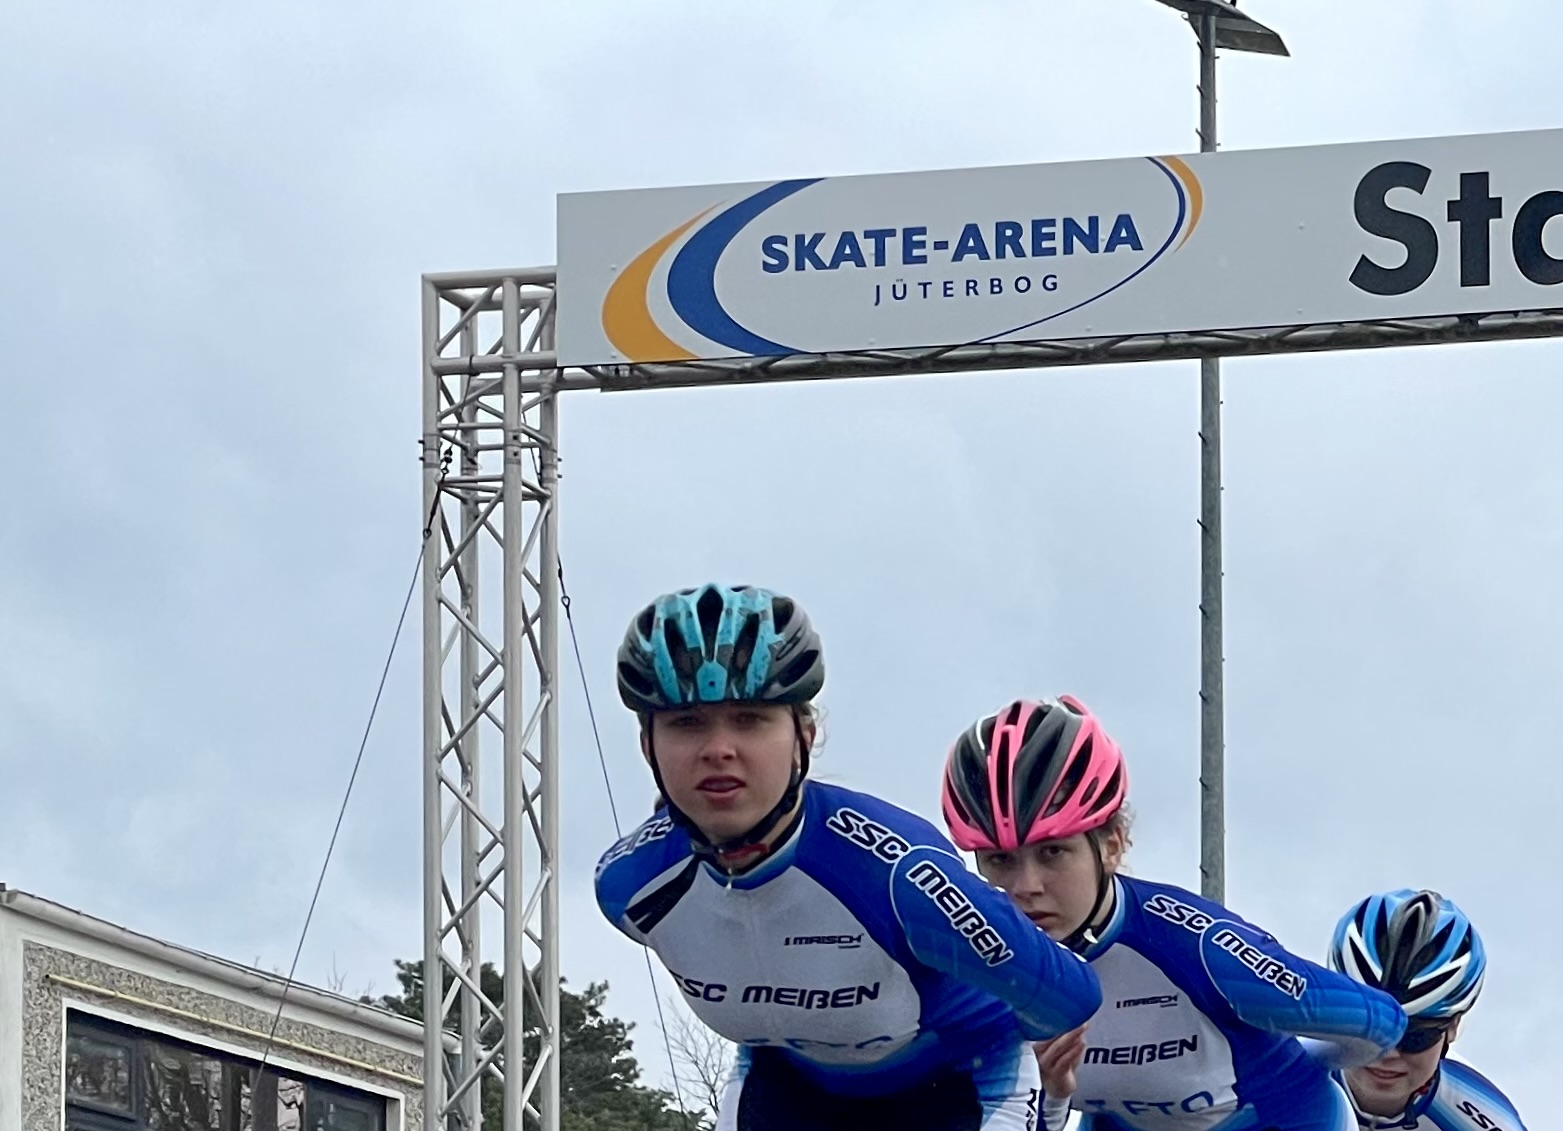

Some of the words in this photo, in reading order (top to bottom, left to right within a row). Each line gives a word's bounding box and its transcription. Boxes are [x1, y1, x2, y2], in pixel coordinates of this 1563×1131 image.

[761, 213, 1143, 275] SKATE-ARENA
[873, 273, 1060, 307] JÜTERBOG
[825, 806, 908, 864] SSC
[1143, 893, 1212, 934] SSC
